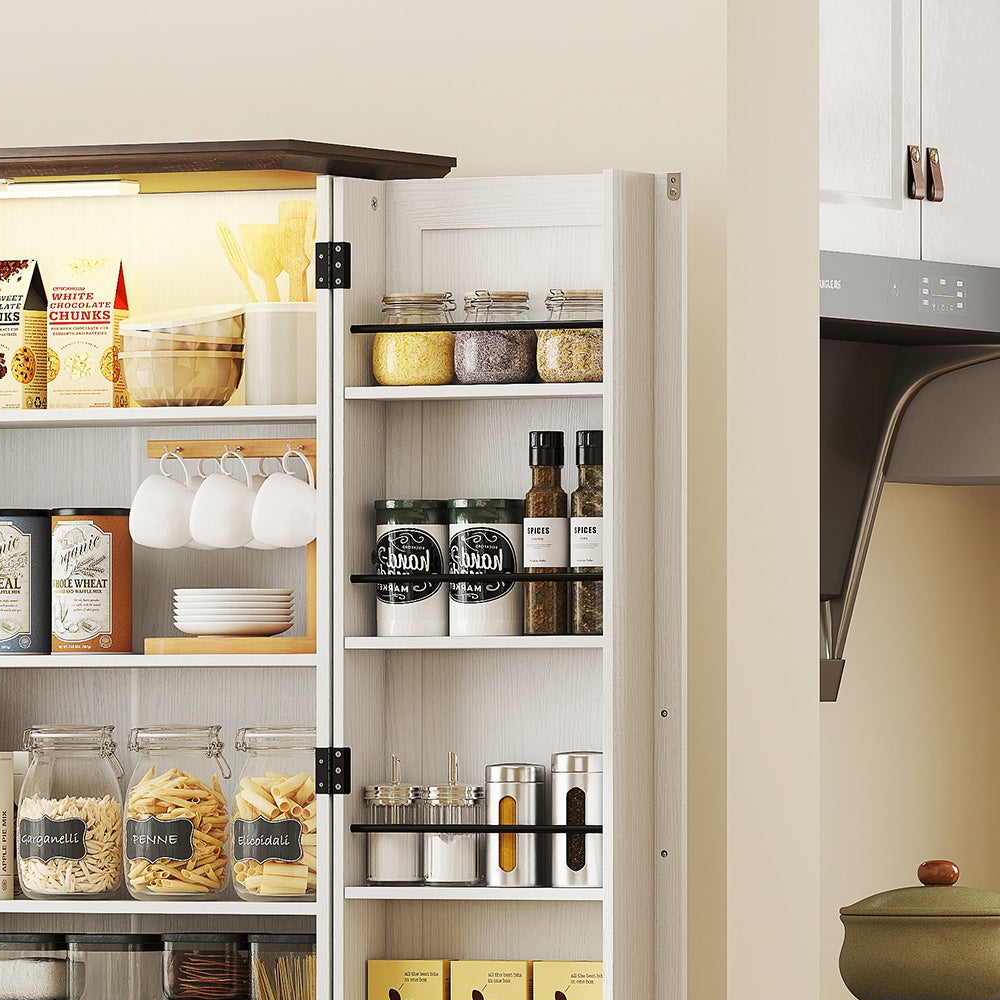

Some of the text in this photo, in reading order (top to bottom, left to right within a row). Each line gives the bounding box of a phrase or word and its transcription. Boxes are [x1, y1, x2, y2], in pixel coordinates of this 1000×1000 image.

[49, 311, 110, 320] CHUNKS
[74, 579, 108, 588] WHEAT
[133, 835, 178, 844] PENNE
[238, 835, 290, 846] Elicoidali
